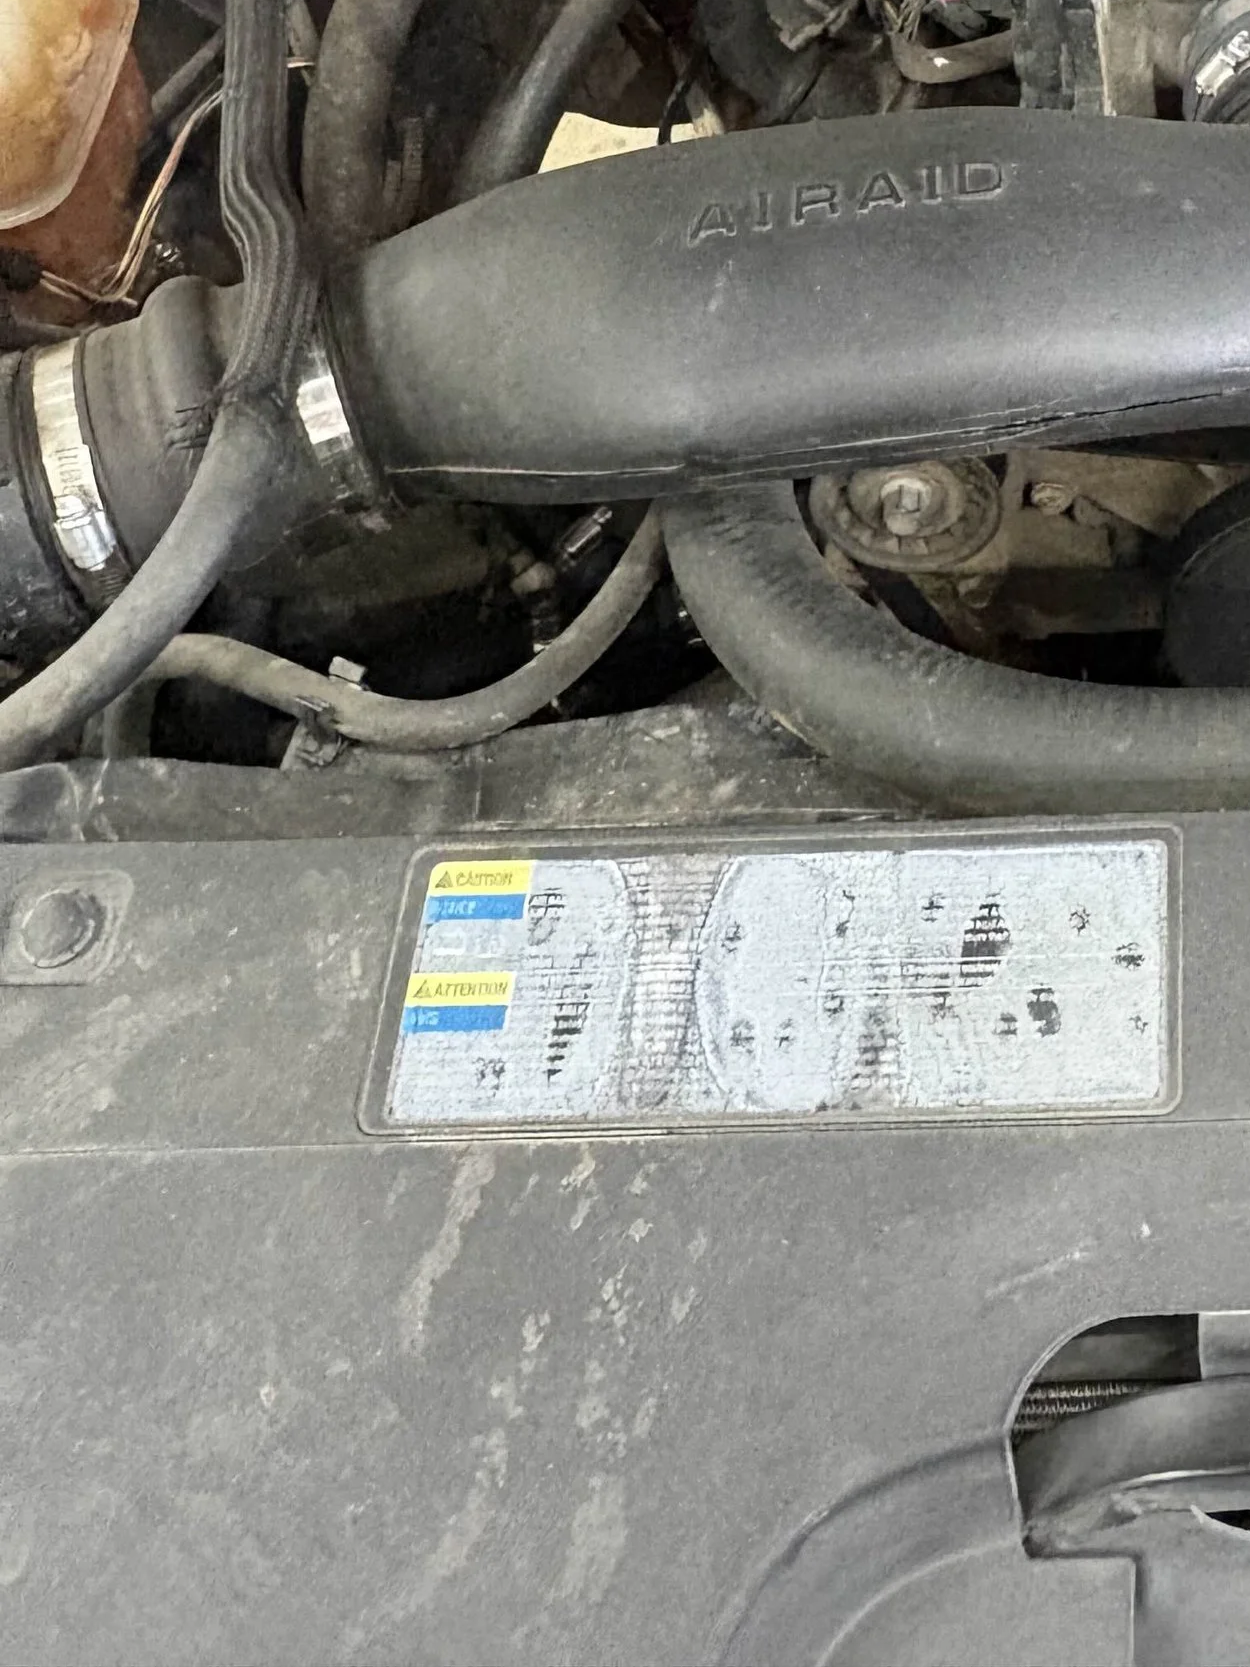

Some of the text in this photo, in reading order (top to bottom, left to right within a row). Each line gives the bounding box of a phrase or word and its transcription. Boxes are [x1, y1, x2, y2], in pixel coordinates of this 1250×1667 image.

[687, 162, 1005, 248] AIRAID
[455, 870, 514, 887] CAUTION
[433, 981, 509, 997] ATTENTION
